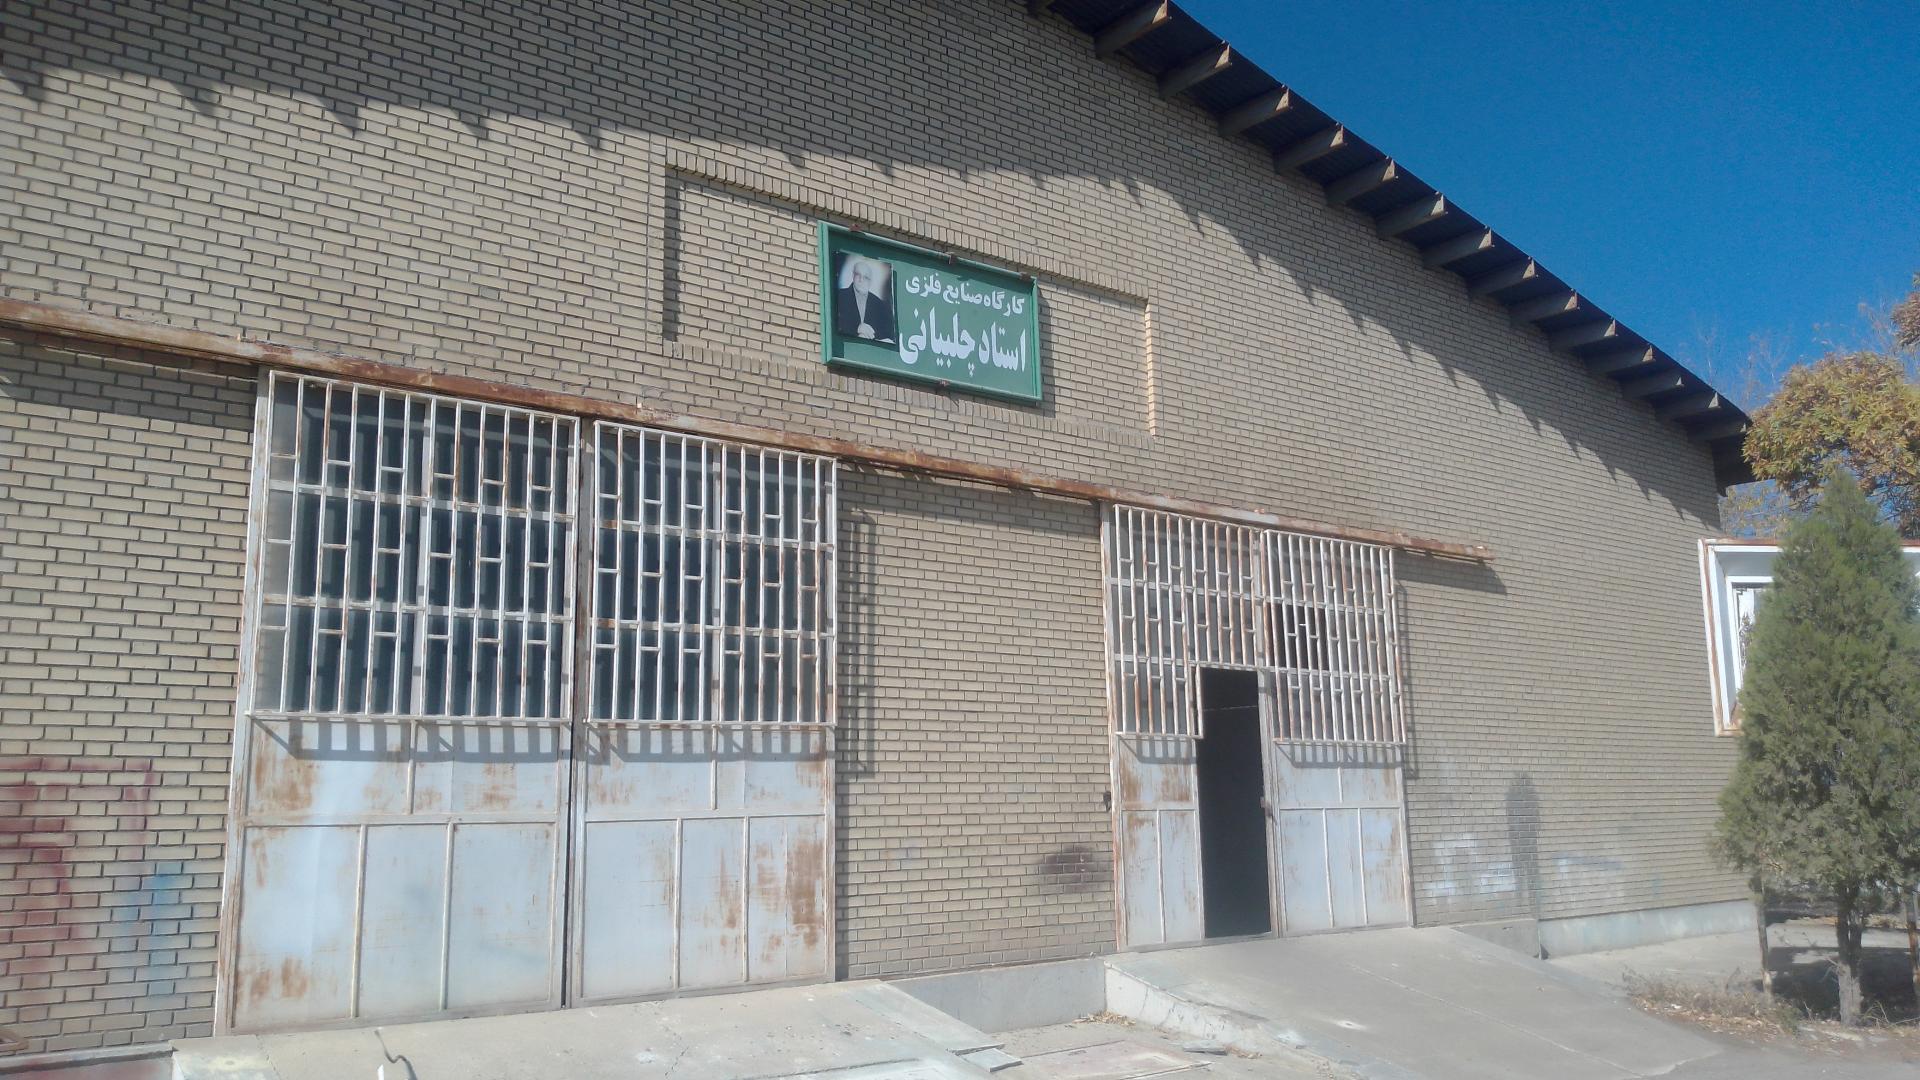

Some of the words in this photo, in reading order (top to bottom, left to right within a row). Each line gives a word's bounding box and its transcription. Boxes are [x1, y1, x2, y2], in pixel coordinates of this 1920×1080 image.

[905, 273, 942, 297] فلزی
[942, 282, 983, 304] صنایع
[983, 291, 1025, 317] کارگاه
[899, 306, 976, 377] چلبیانی
[978, 321, 1026, 372] استاد
